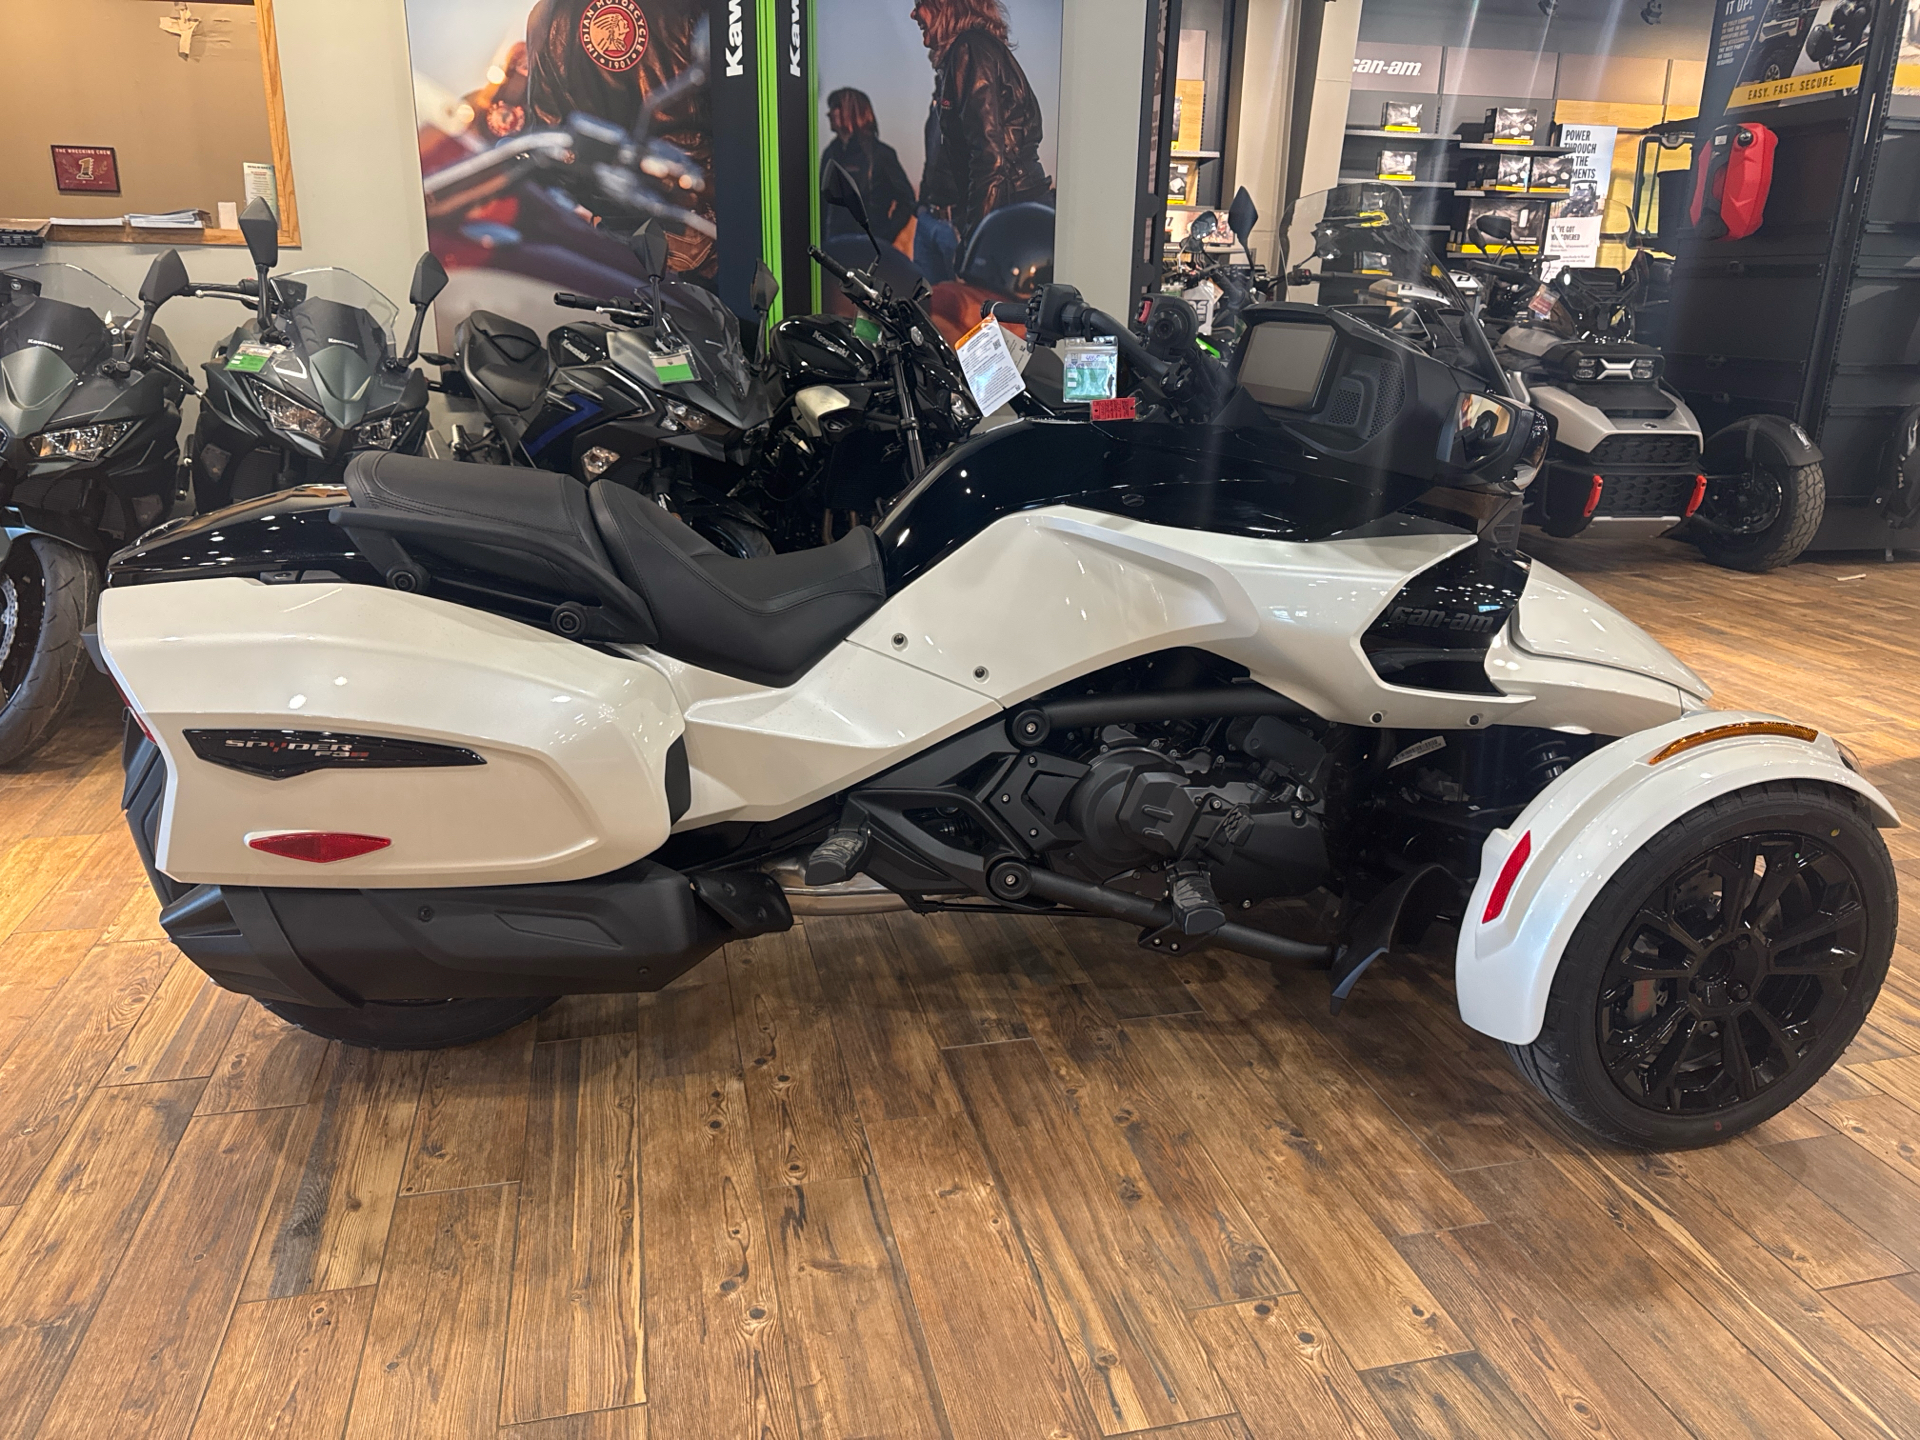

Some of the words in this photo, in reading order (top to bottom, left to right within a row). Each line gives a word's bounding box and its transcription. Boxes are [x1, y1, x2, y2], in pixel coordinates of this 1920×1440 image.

[1725, 0, 1735, 16] IT
[582, 9, 598, 58] INDIAN
[608, 59, 631, 69] 1901
[1748, 87, 1770, 100] EASY.
[1773, 83, 1796, 95] FAST.
[1799, 75, 1837, 91] SECURE.
[1565, 129, 1591, 141] POWER
[1575, 156, 1589, 167] THE
[27, 338, 64, 351] Kawasaki
[561, 338, 591, 362] Kawasaki
[812, 330, 850, 358] Kawasaki
[1389, 606, 1494, 633] can-am
[225, 739, 353, 753] SPYDER
